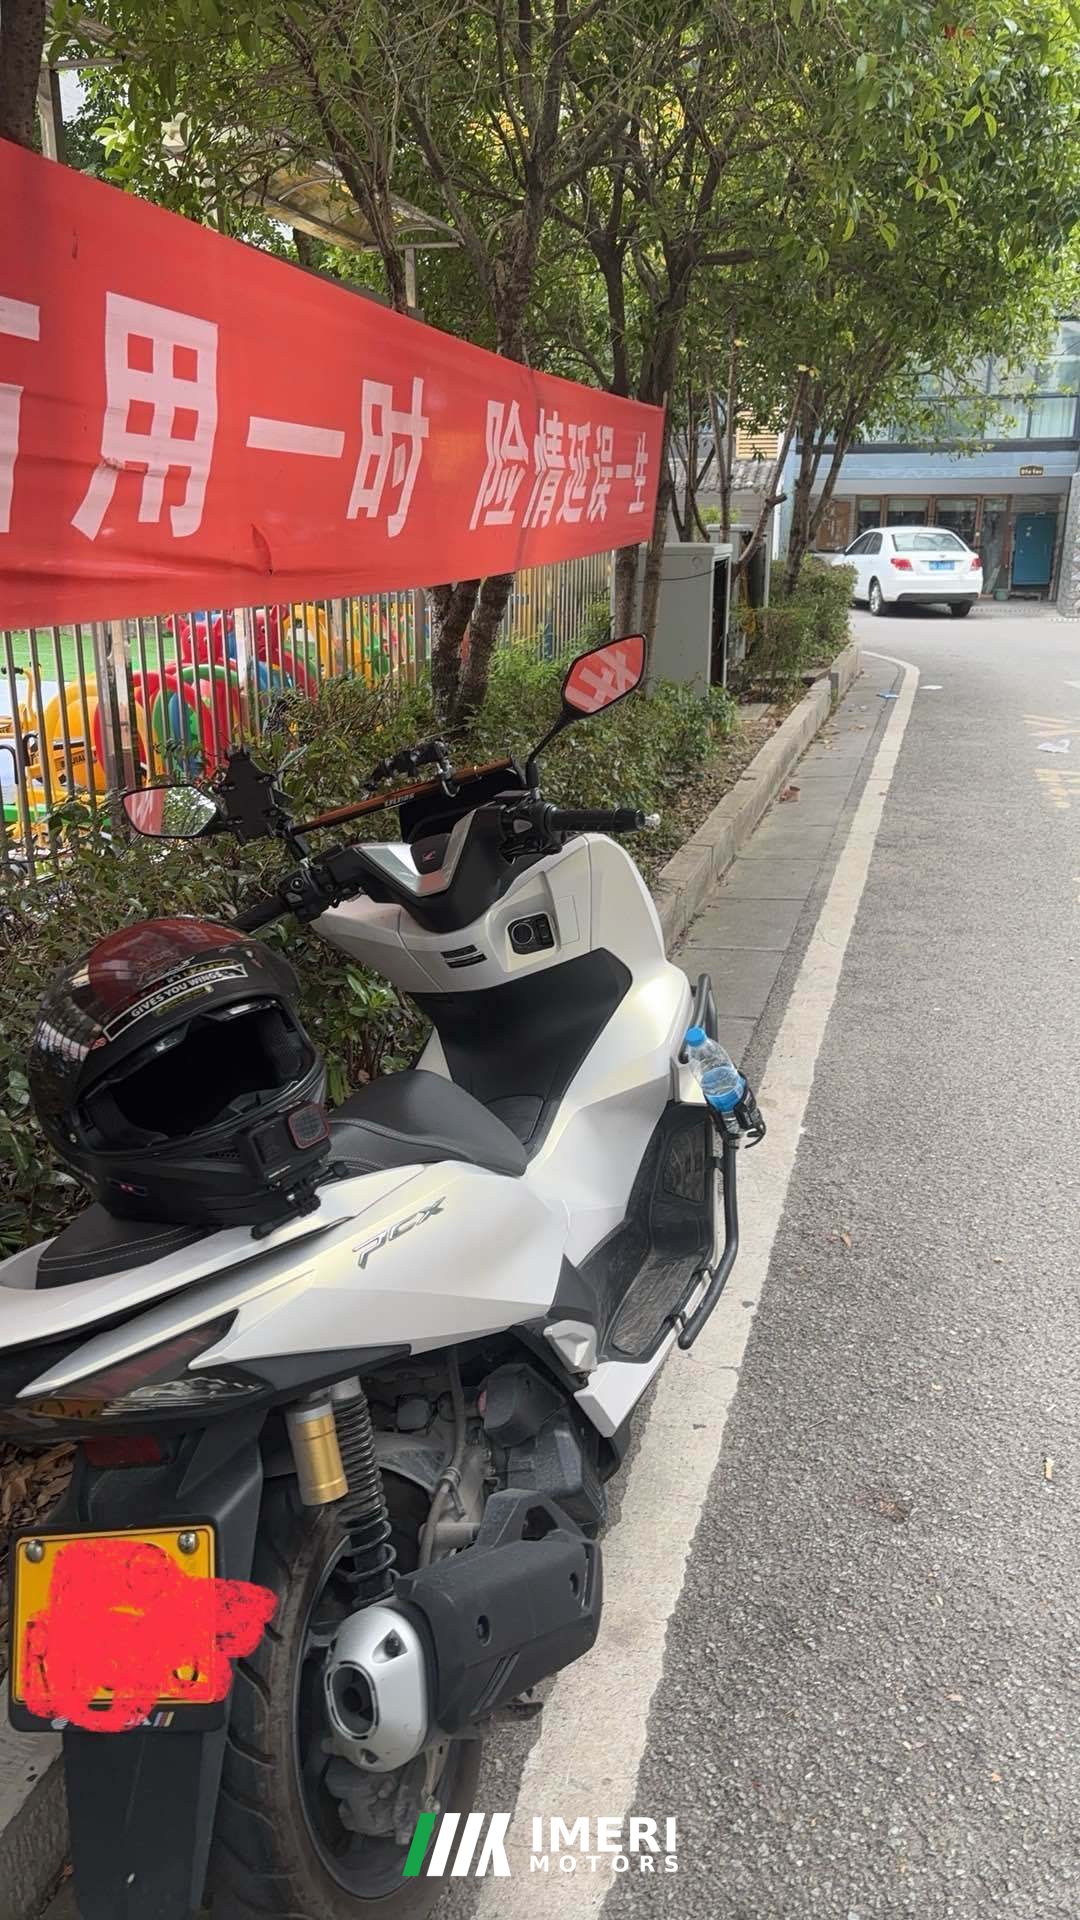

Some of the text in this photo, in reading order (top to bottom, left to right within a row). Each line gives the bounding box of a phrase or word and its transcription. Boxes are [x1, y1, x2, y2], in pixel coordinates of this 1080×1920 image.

[0, 291, 649, 542] 用一时 险情延误一生
[131, 993, 164, 1018] GIVES
[164, 982, 188, 998] YOU
[188, 970, 224, 988] WINGS
[352, 1196, 446, 1270] PCX
